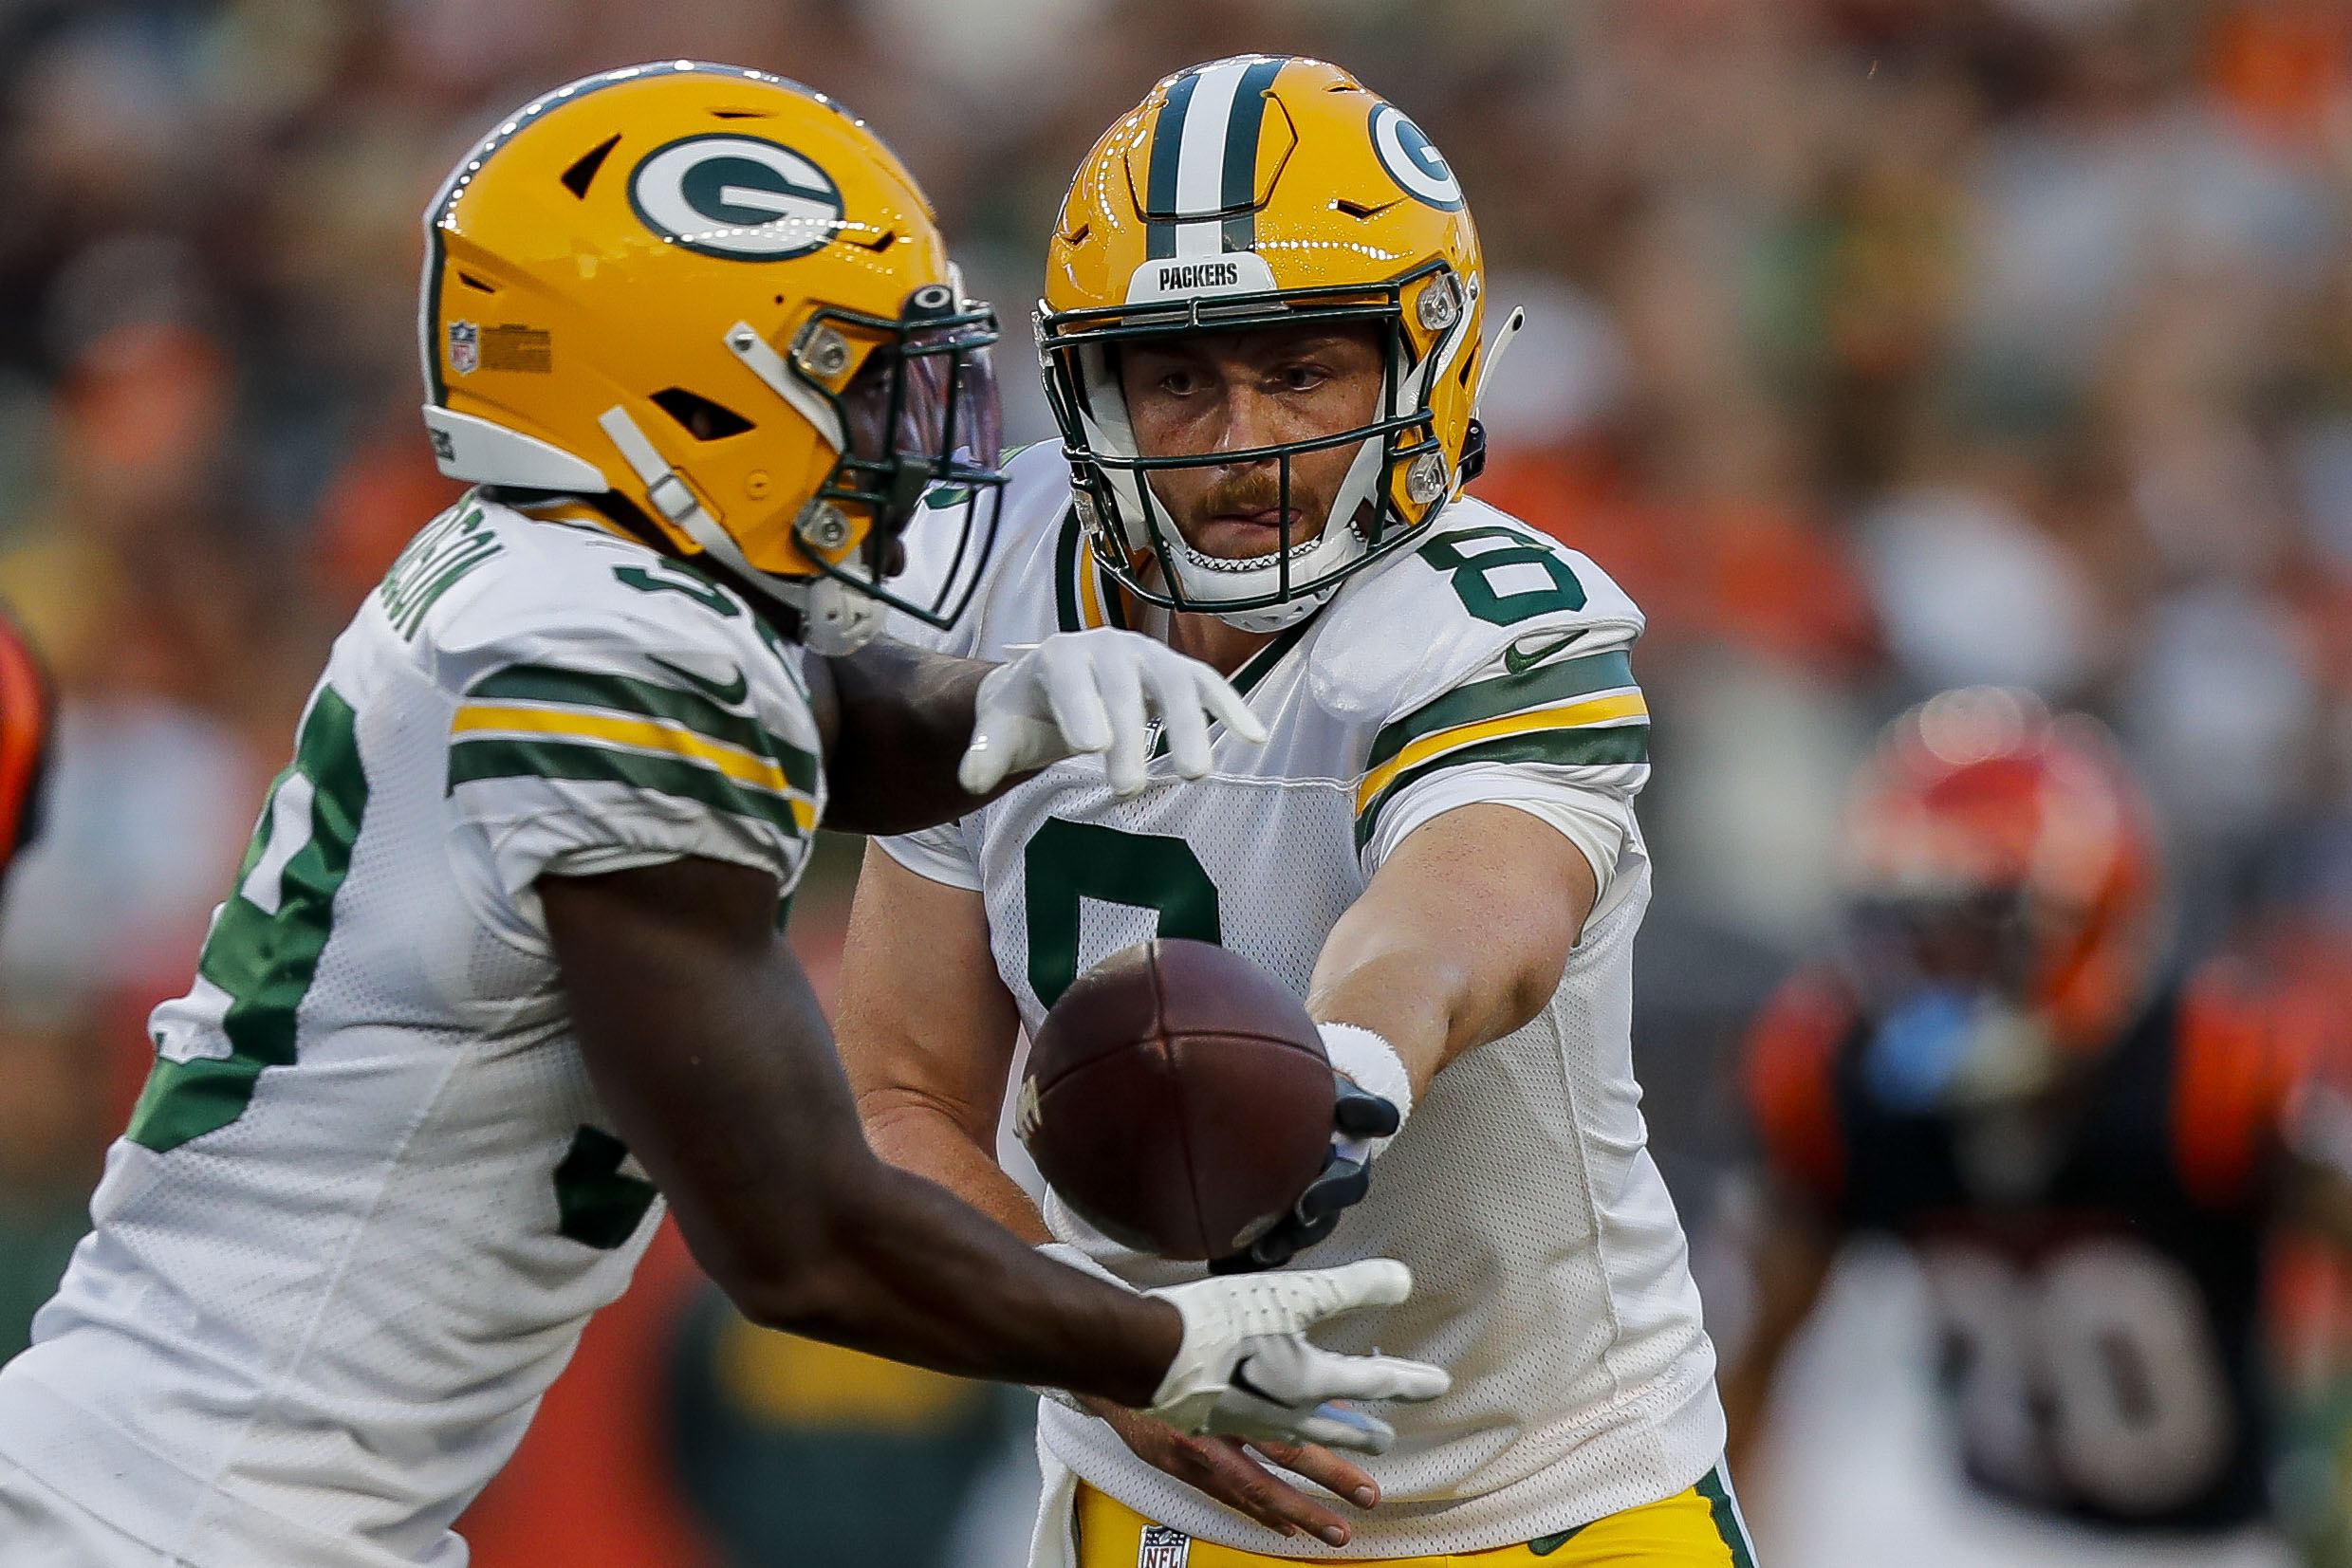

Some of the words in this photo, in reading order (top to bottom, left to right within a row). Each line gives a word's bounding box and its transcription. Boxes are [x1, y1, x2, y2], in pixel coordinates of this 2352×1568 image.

[631, 136, 843, 258] G
[1158, 262, 1238, 291] PACKERS
[1416, 526, 1588, 628] 8
